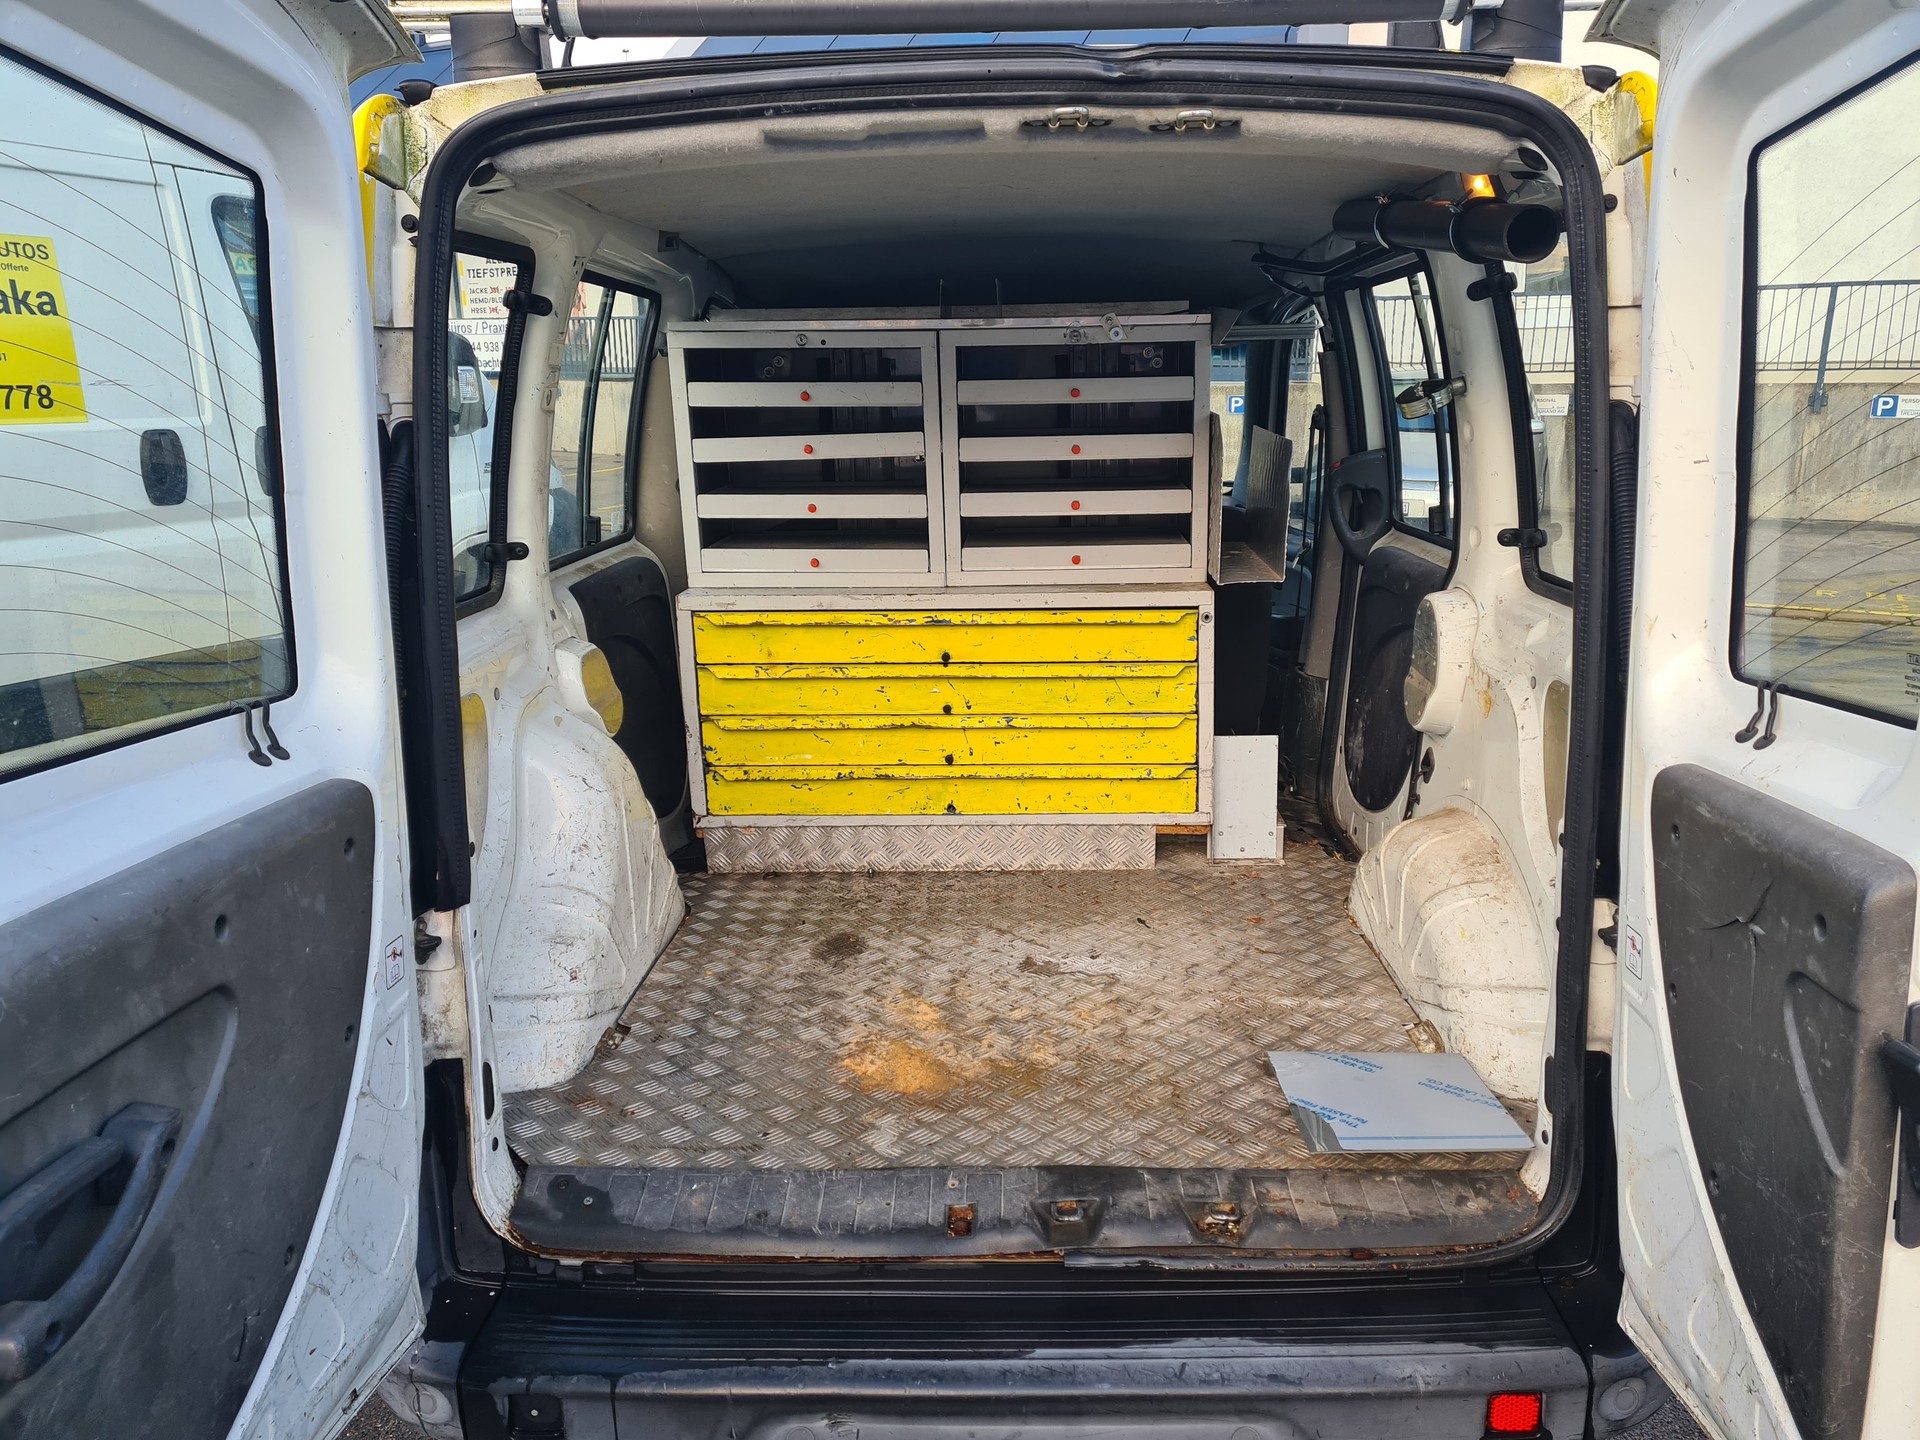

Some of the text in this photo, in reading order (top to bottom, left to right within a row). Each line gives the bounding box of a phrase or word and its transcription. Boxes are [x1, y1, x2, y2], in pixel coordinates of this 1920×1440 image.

[0, 262, 29, 272] Offerte
[466, 267, 517, 279] TIEFSTPRE
[448, 321, 472, 334] üros
[483, 341, 500, 353] 938
[0, 384, 54, 410] 778
[1231, 397, 1244, 412] P
[1876, 397, 1895, 417] P
